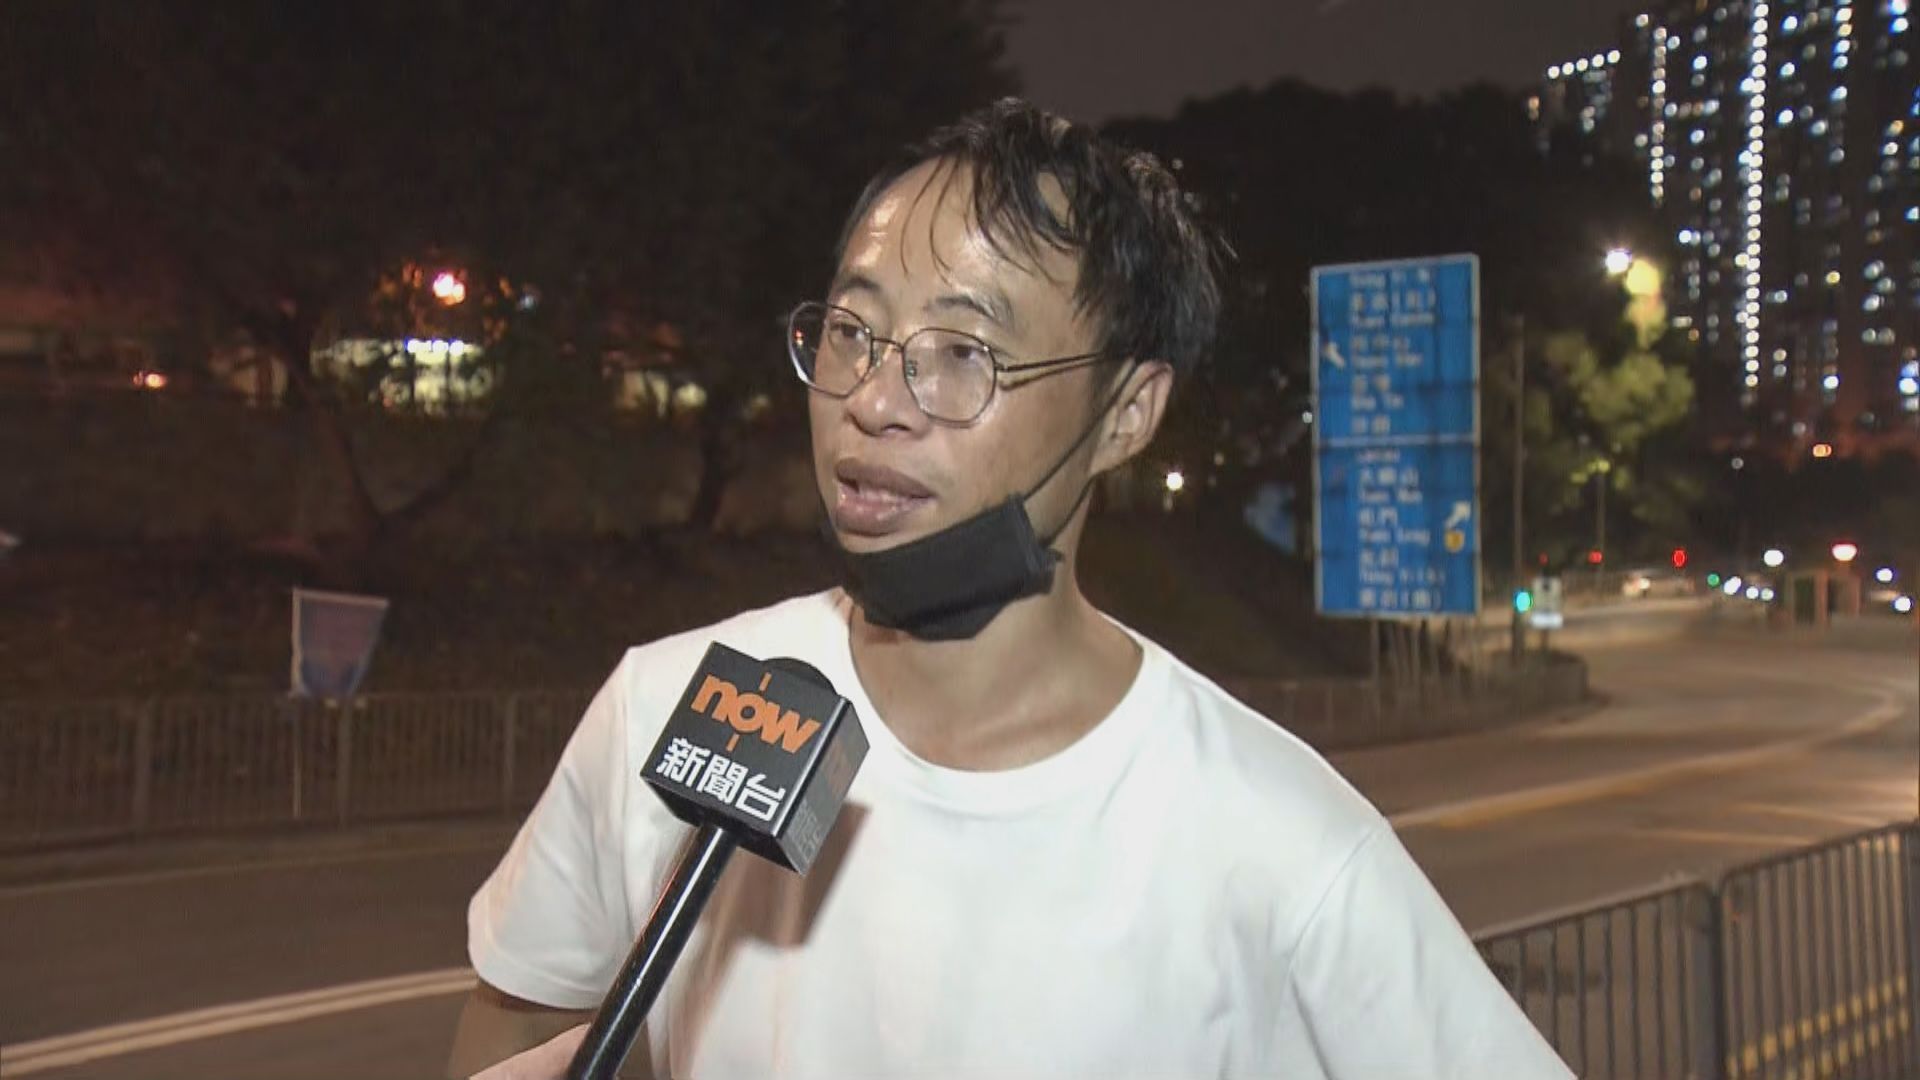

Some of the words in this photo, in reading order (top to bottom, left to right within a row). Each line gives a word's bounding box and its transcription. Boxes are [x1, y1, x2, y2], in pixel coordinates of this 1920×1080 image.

[691, 673, 821, 754] now
[656, 737, 786, 822] 新聞台
